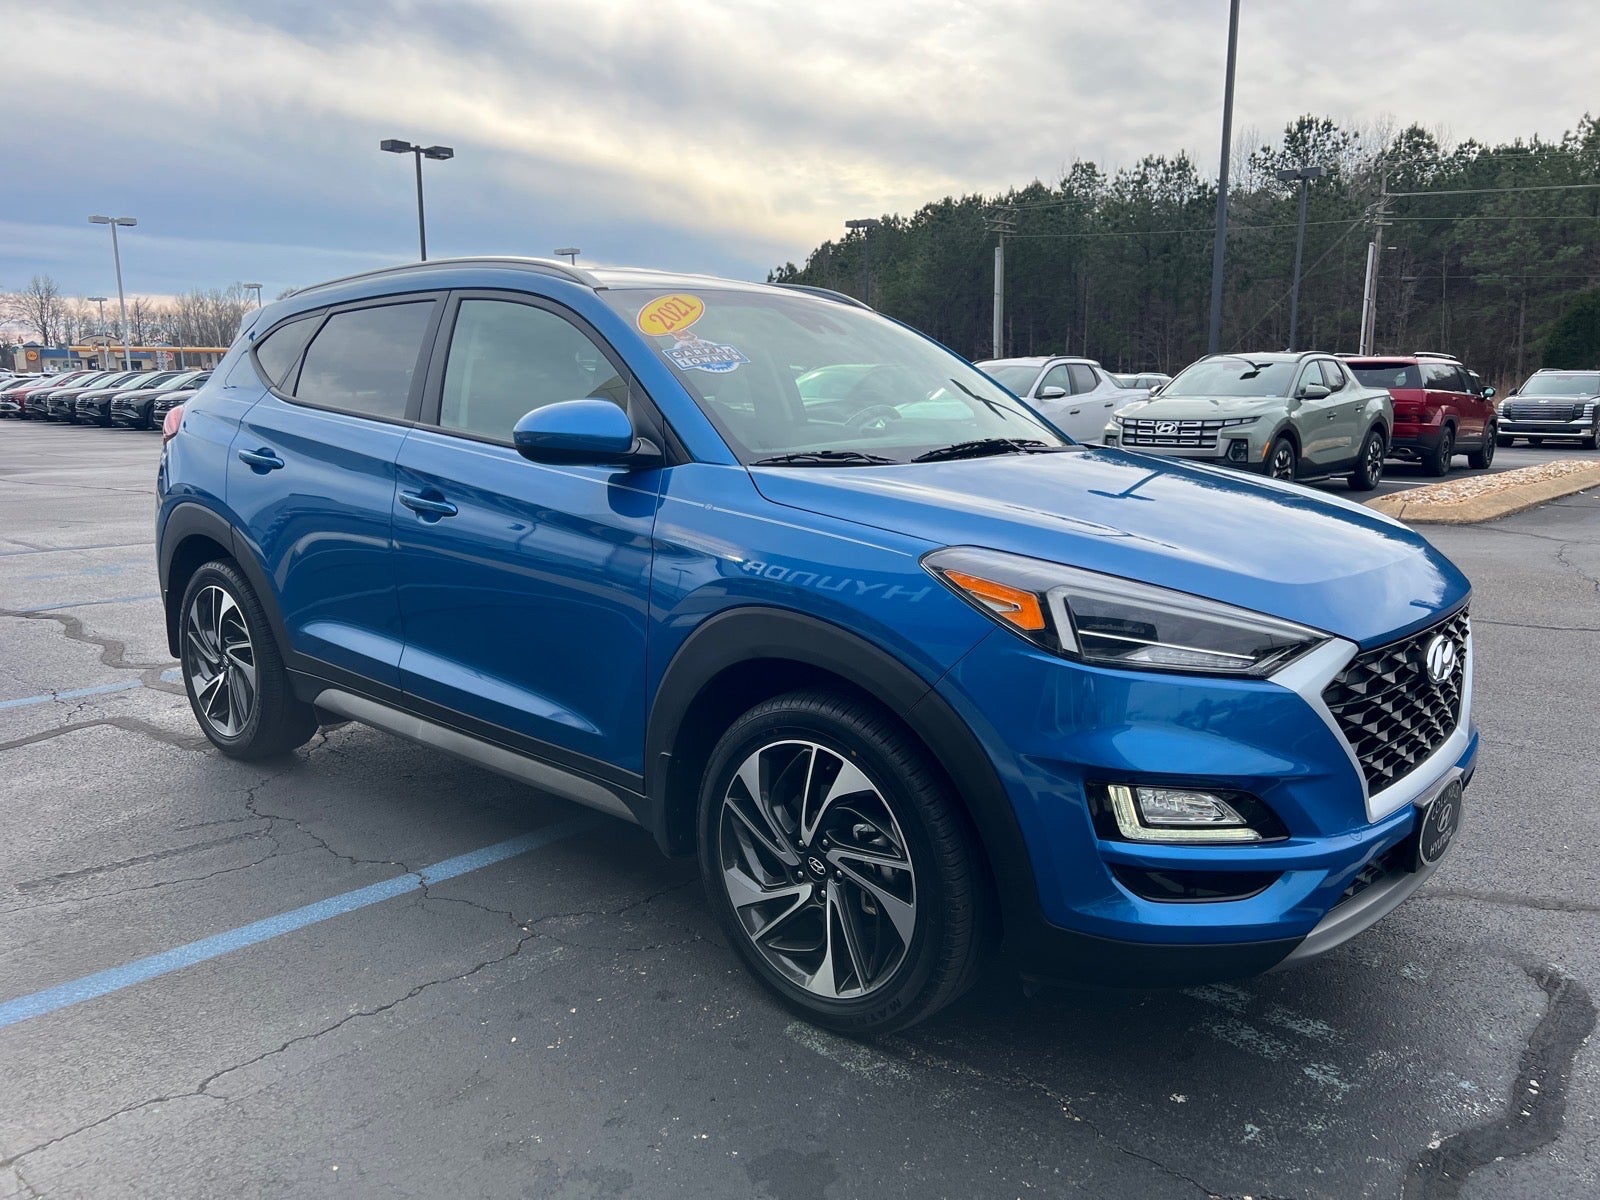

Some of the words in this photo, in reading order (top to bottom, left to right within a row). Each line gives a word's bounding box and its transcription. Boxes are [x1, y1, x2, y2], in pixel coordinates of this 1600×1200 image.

[648, 296, 697, 330] 2021
[672, 345, 737, 358] CARFAX
[691, 353, 742, 365] OWNER
